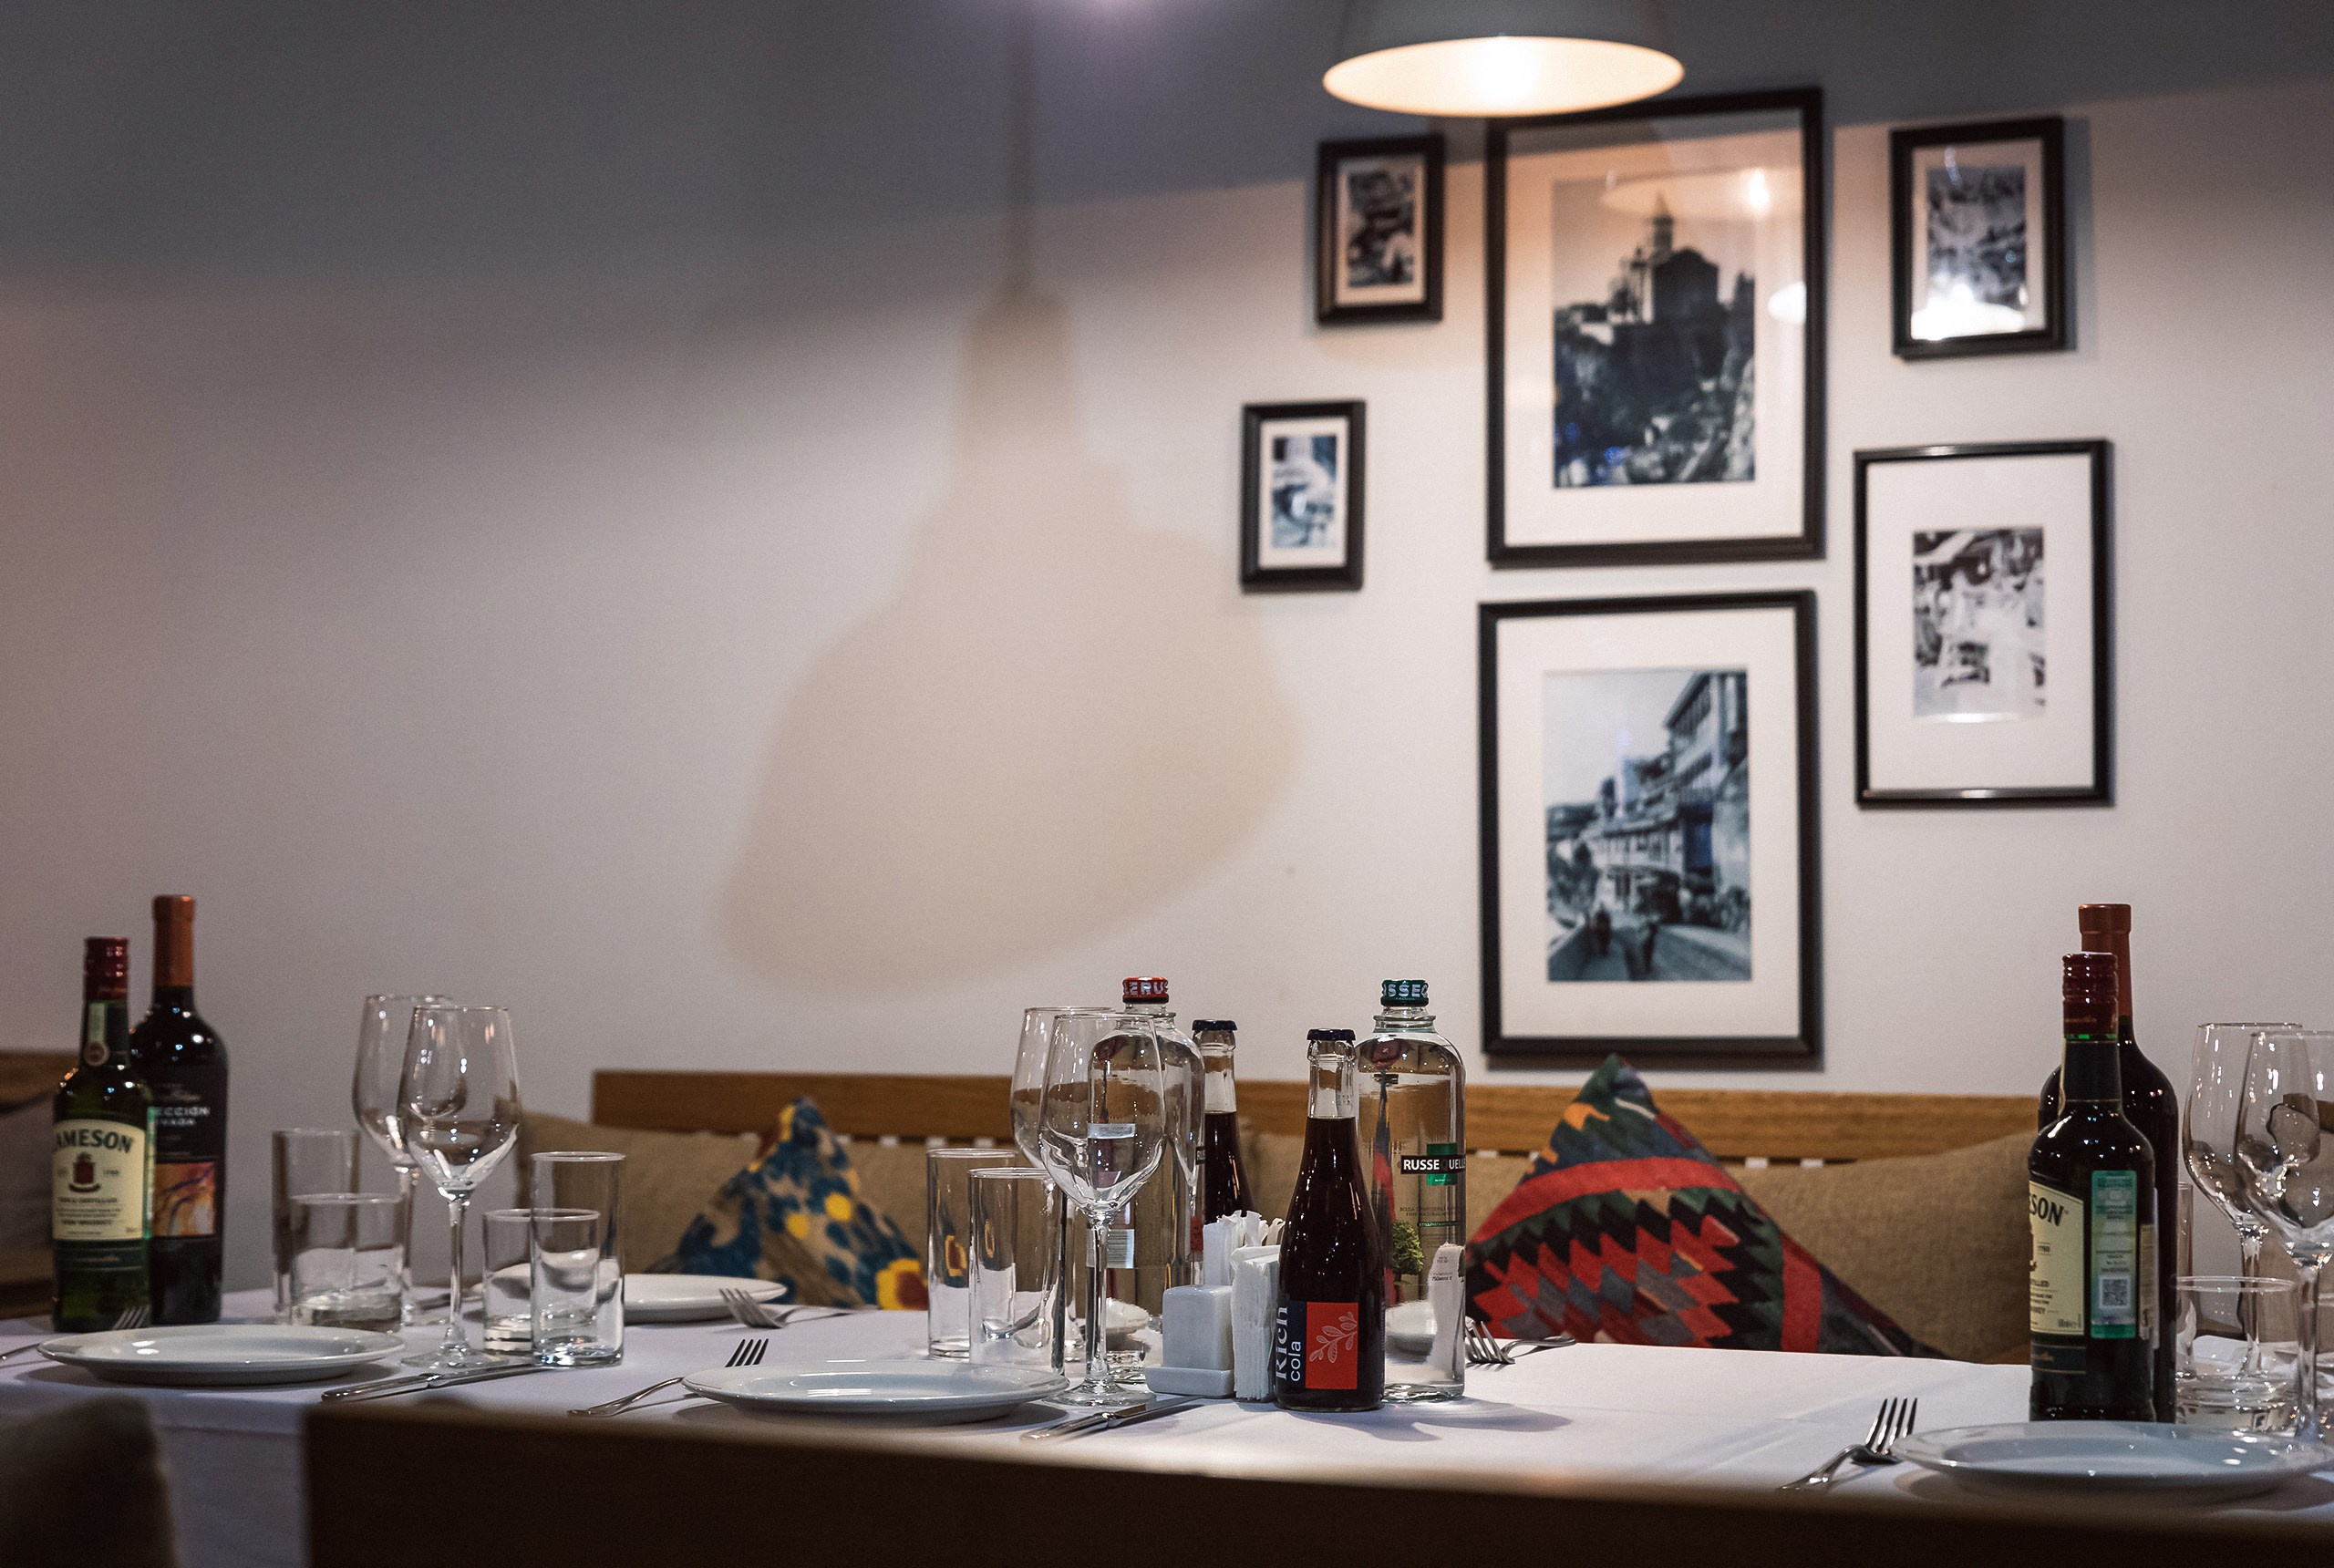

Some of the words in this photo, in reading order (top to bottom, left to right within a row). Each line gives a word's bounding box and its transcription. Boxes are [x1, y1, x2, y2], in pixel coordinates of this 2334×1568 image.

[56, 1129, 134, 1153] AMESON
[1403, 1159, 1440, 1171] RUSSE
[2029, 1193, 2064, 1227] SON
[1287, 1341, 1302, 1381] cola
